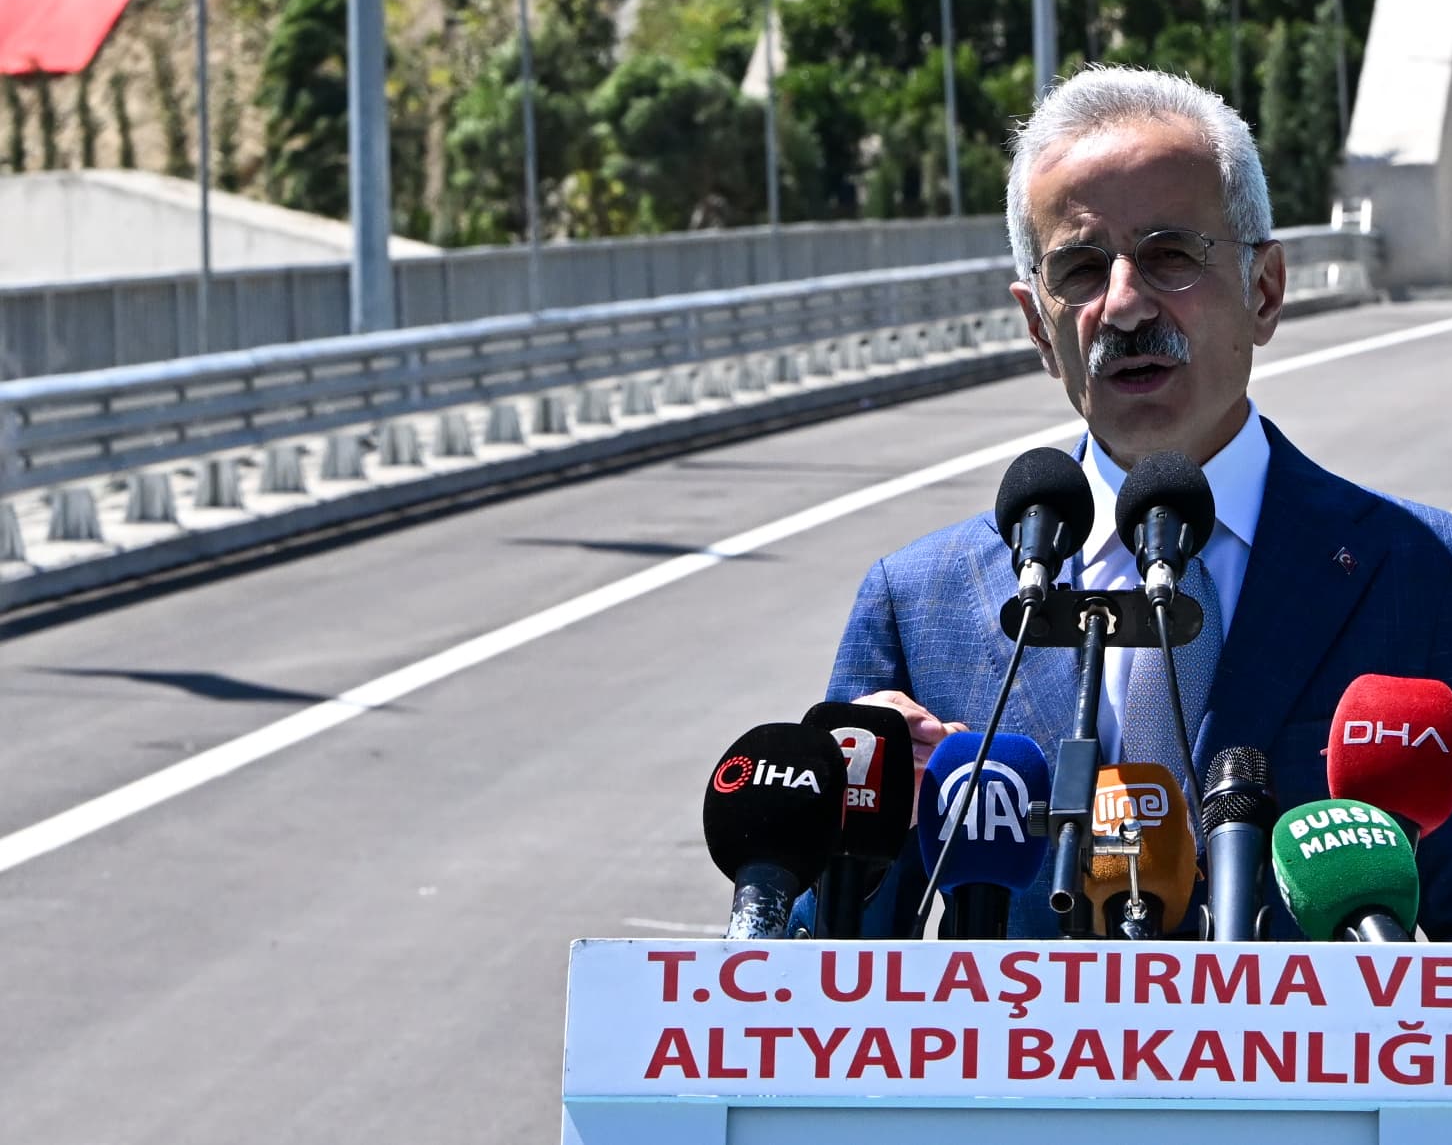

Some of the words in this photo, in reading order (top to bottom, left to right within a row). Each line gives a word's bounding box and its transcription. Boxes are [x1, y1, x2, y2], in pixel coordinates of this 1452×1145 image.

[1343, 720, 1449, 753] DHA
[753, 759, 821, 794] İHA
[845, 787, 876, 808] BR
[1288, 807, 1392, 840] BURSA
[1299, 827, 1398, 860] MANŞET
[649, 951, 791, 1002] T.C.
[822, 951, 1326, 1018] ULAŞTIRMA
[646, 1028, 978, 1079] ALTYAPI
